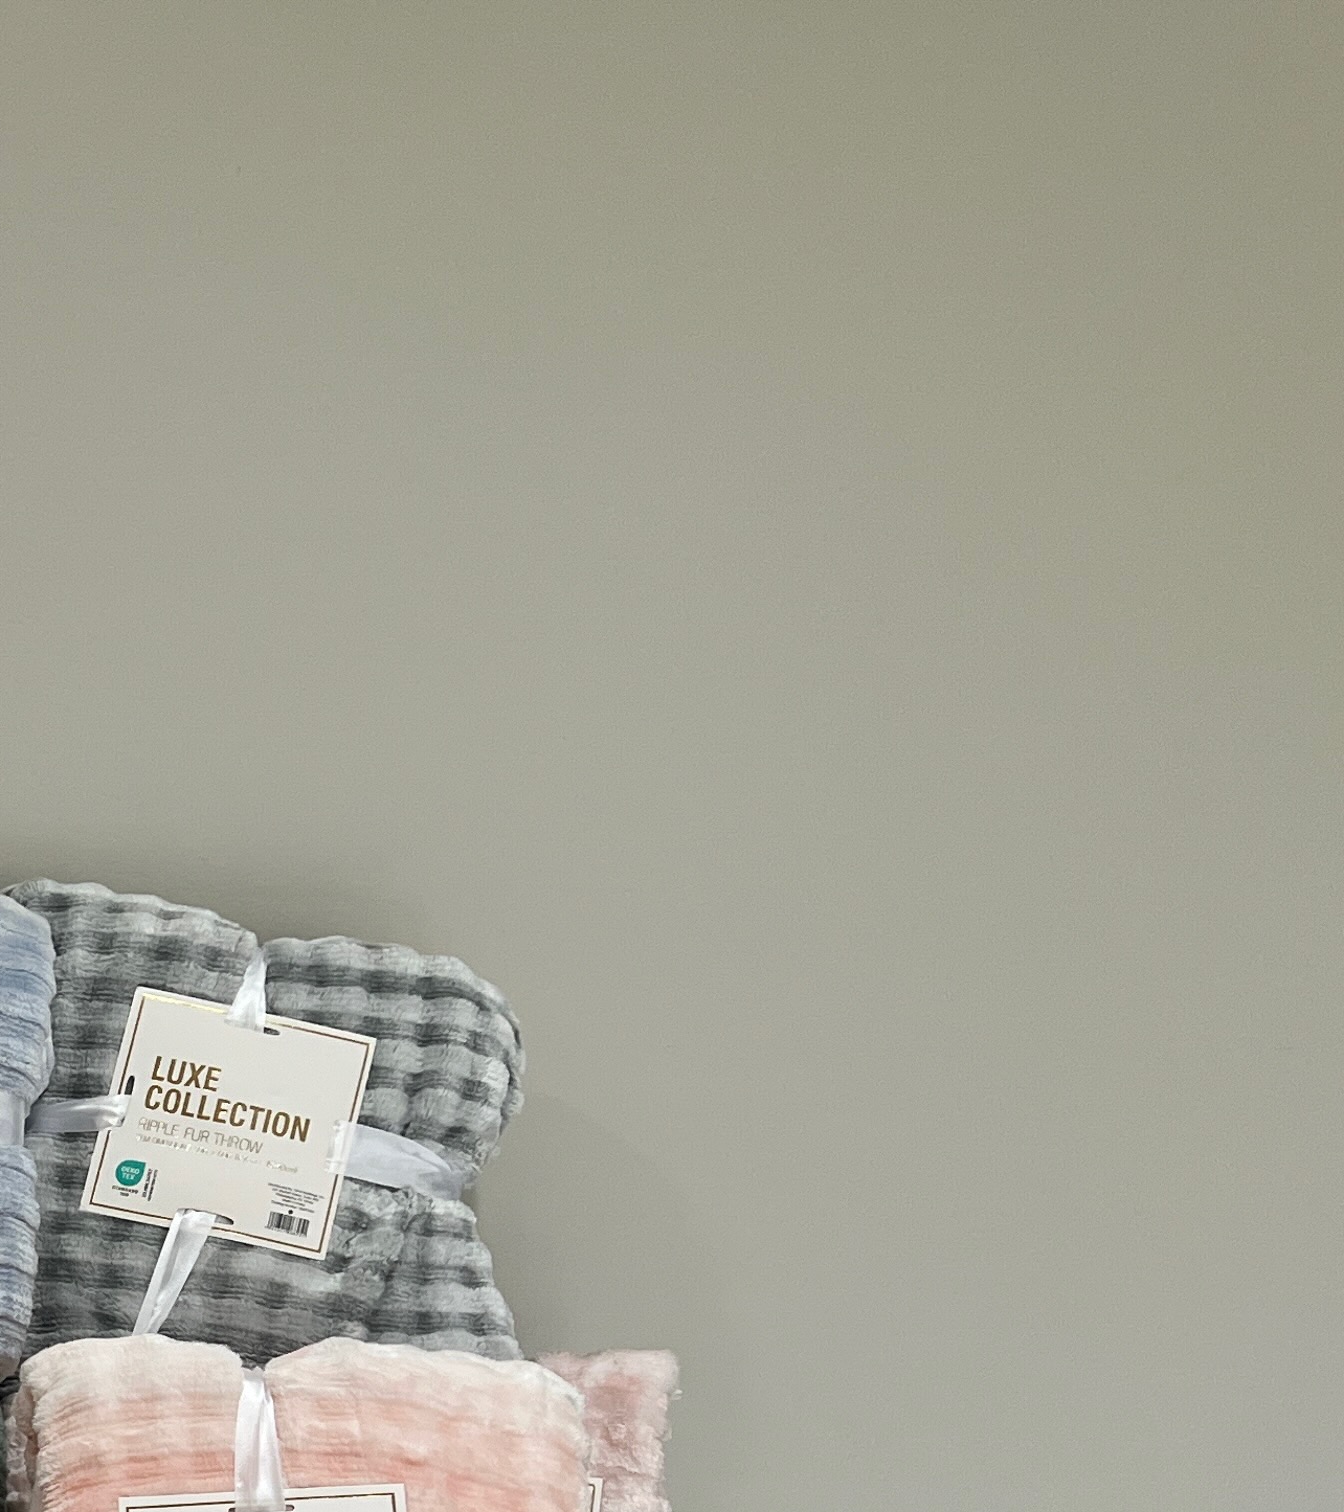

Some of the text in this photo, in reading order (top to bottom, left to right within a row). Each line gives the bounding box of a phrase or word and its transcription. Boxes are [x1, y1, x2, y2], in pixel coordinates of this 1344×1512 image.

[151, 1056, 222, 1092] LUXE
[144, 1085, 311, 1143] COLLECTION
[138, 1117, 180, 1137] RIPPLE
[184, 1125, 210, 1143] FUR
[214, 1132, 264, 1154] THROW
